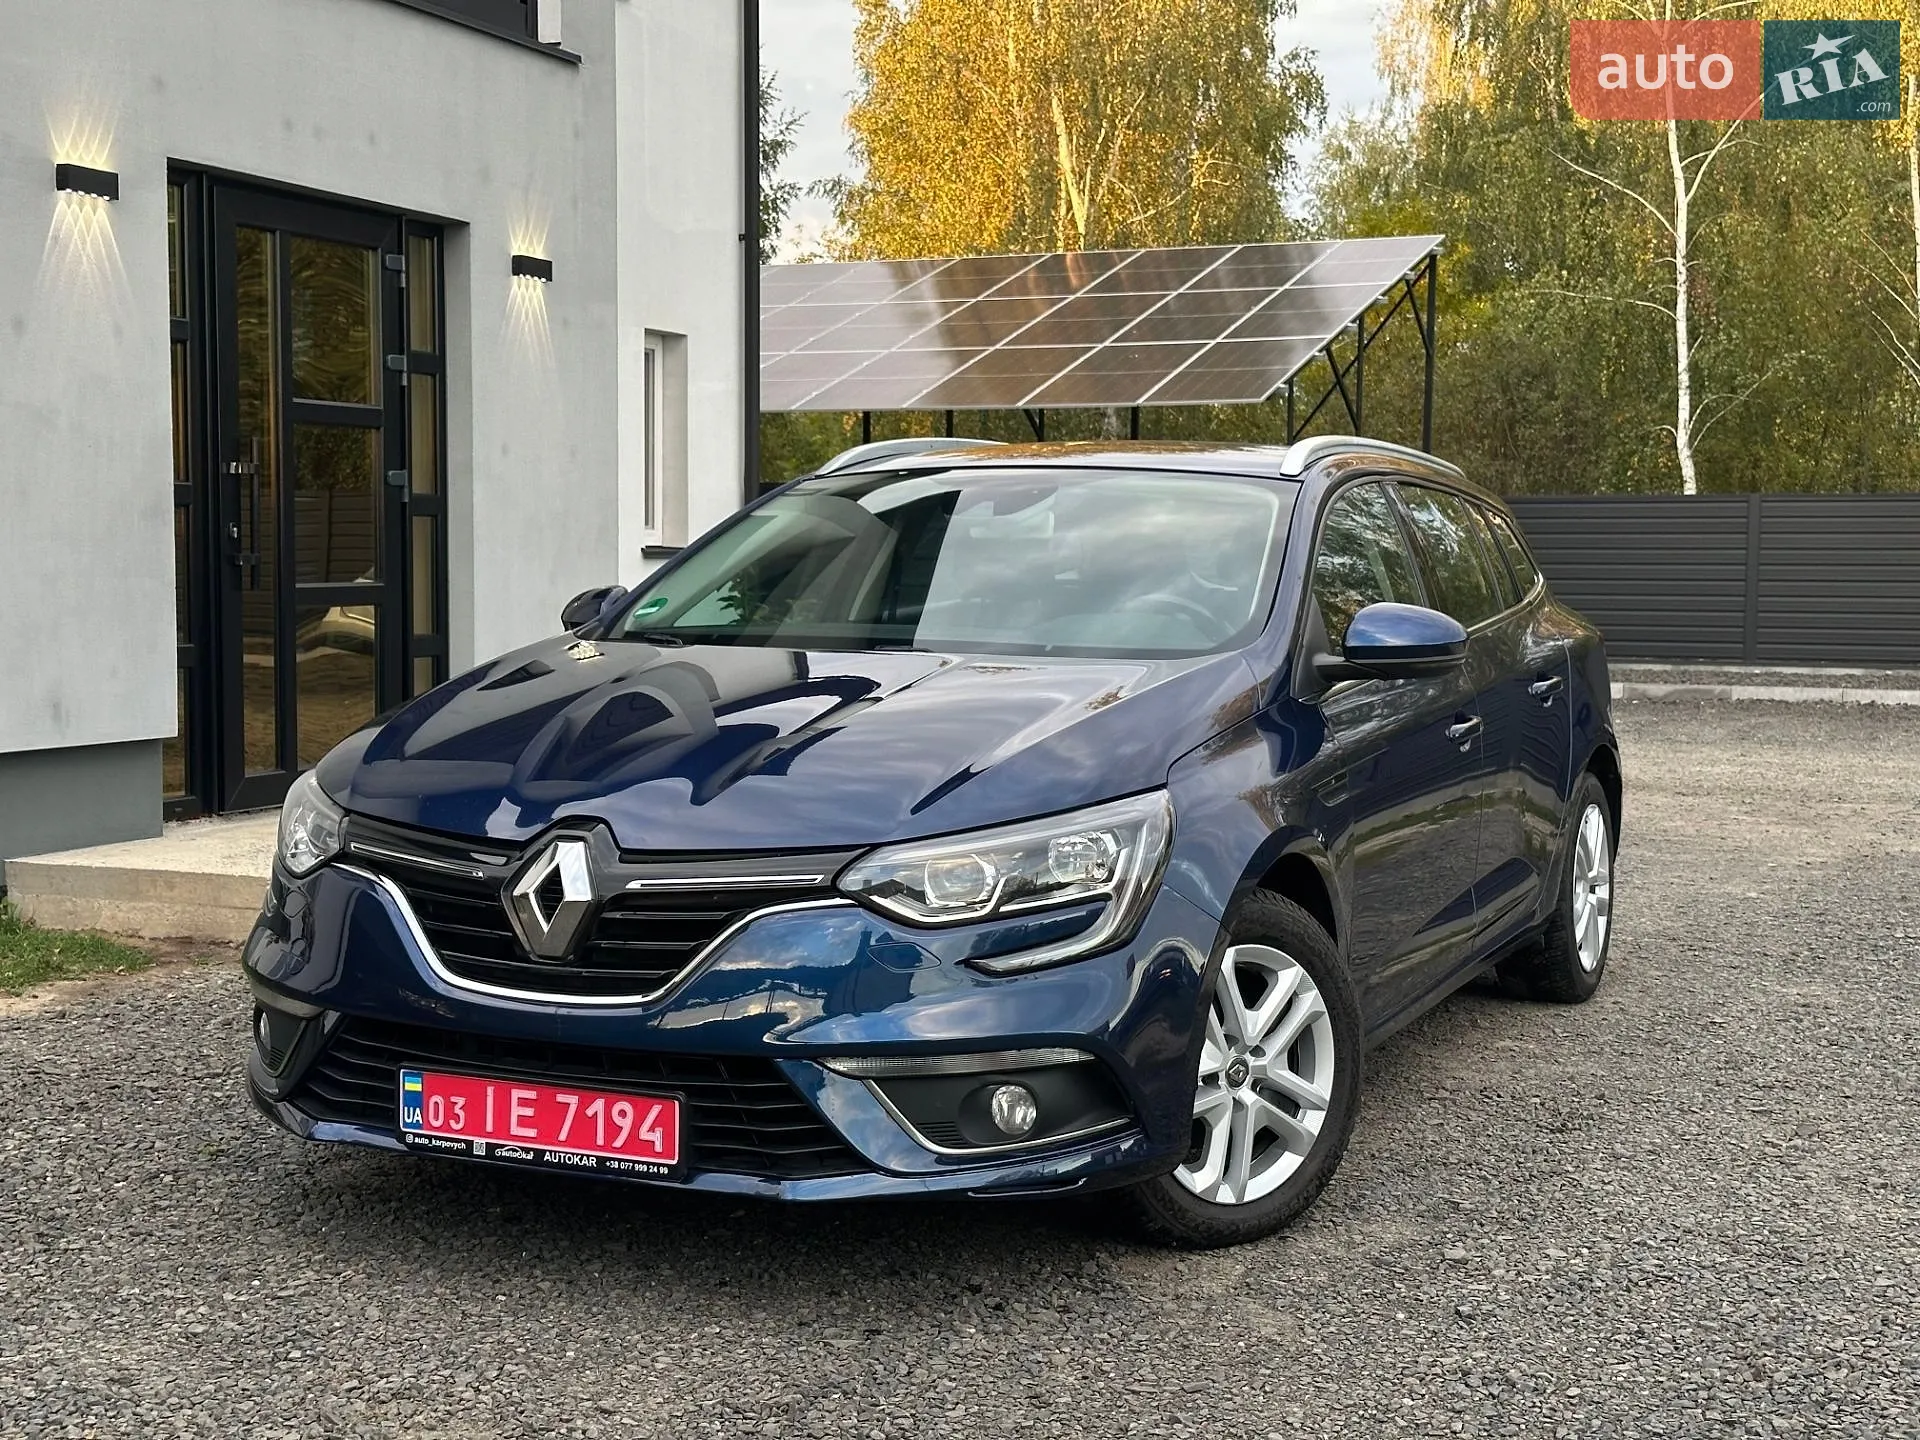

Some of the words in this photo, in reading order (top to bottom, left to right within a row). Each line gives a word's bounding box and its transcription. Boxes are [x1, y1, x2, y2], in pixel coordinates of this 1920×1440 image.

[404, 1106, 423, 1124] UA
[428, 1094, 467, 1131] 03
[486, 1086, 538, 1138] IE
[555, 1093, 663, 1153] 7194
[543, 1151, 597, 1168] AUTOKAR
[605, 1160, 619, 1170] +38
[620, 1161, 633, 1171] 077
